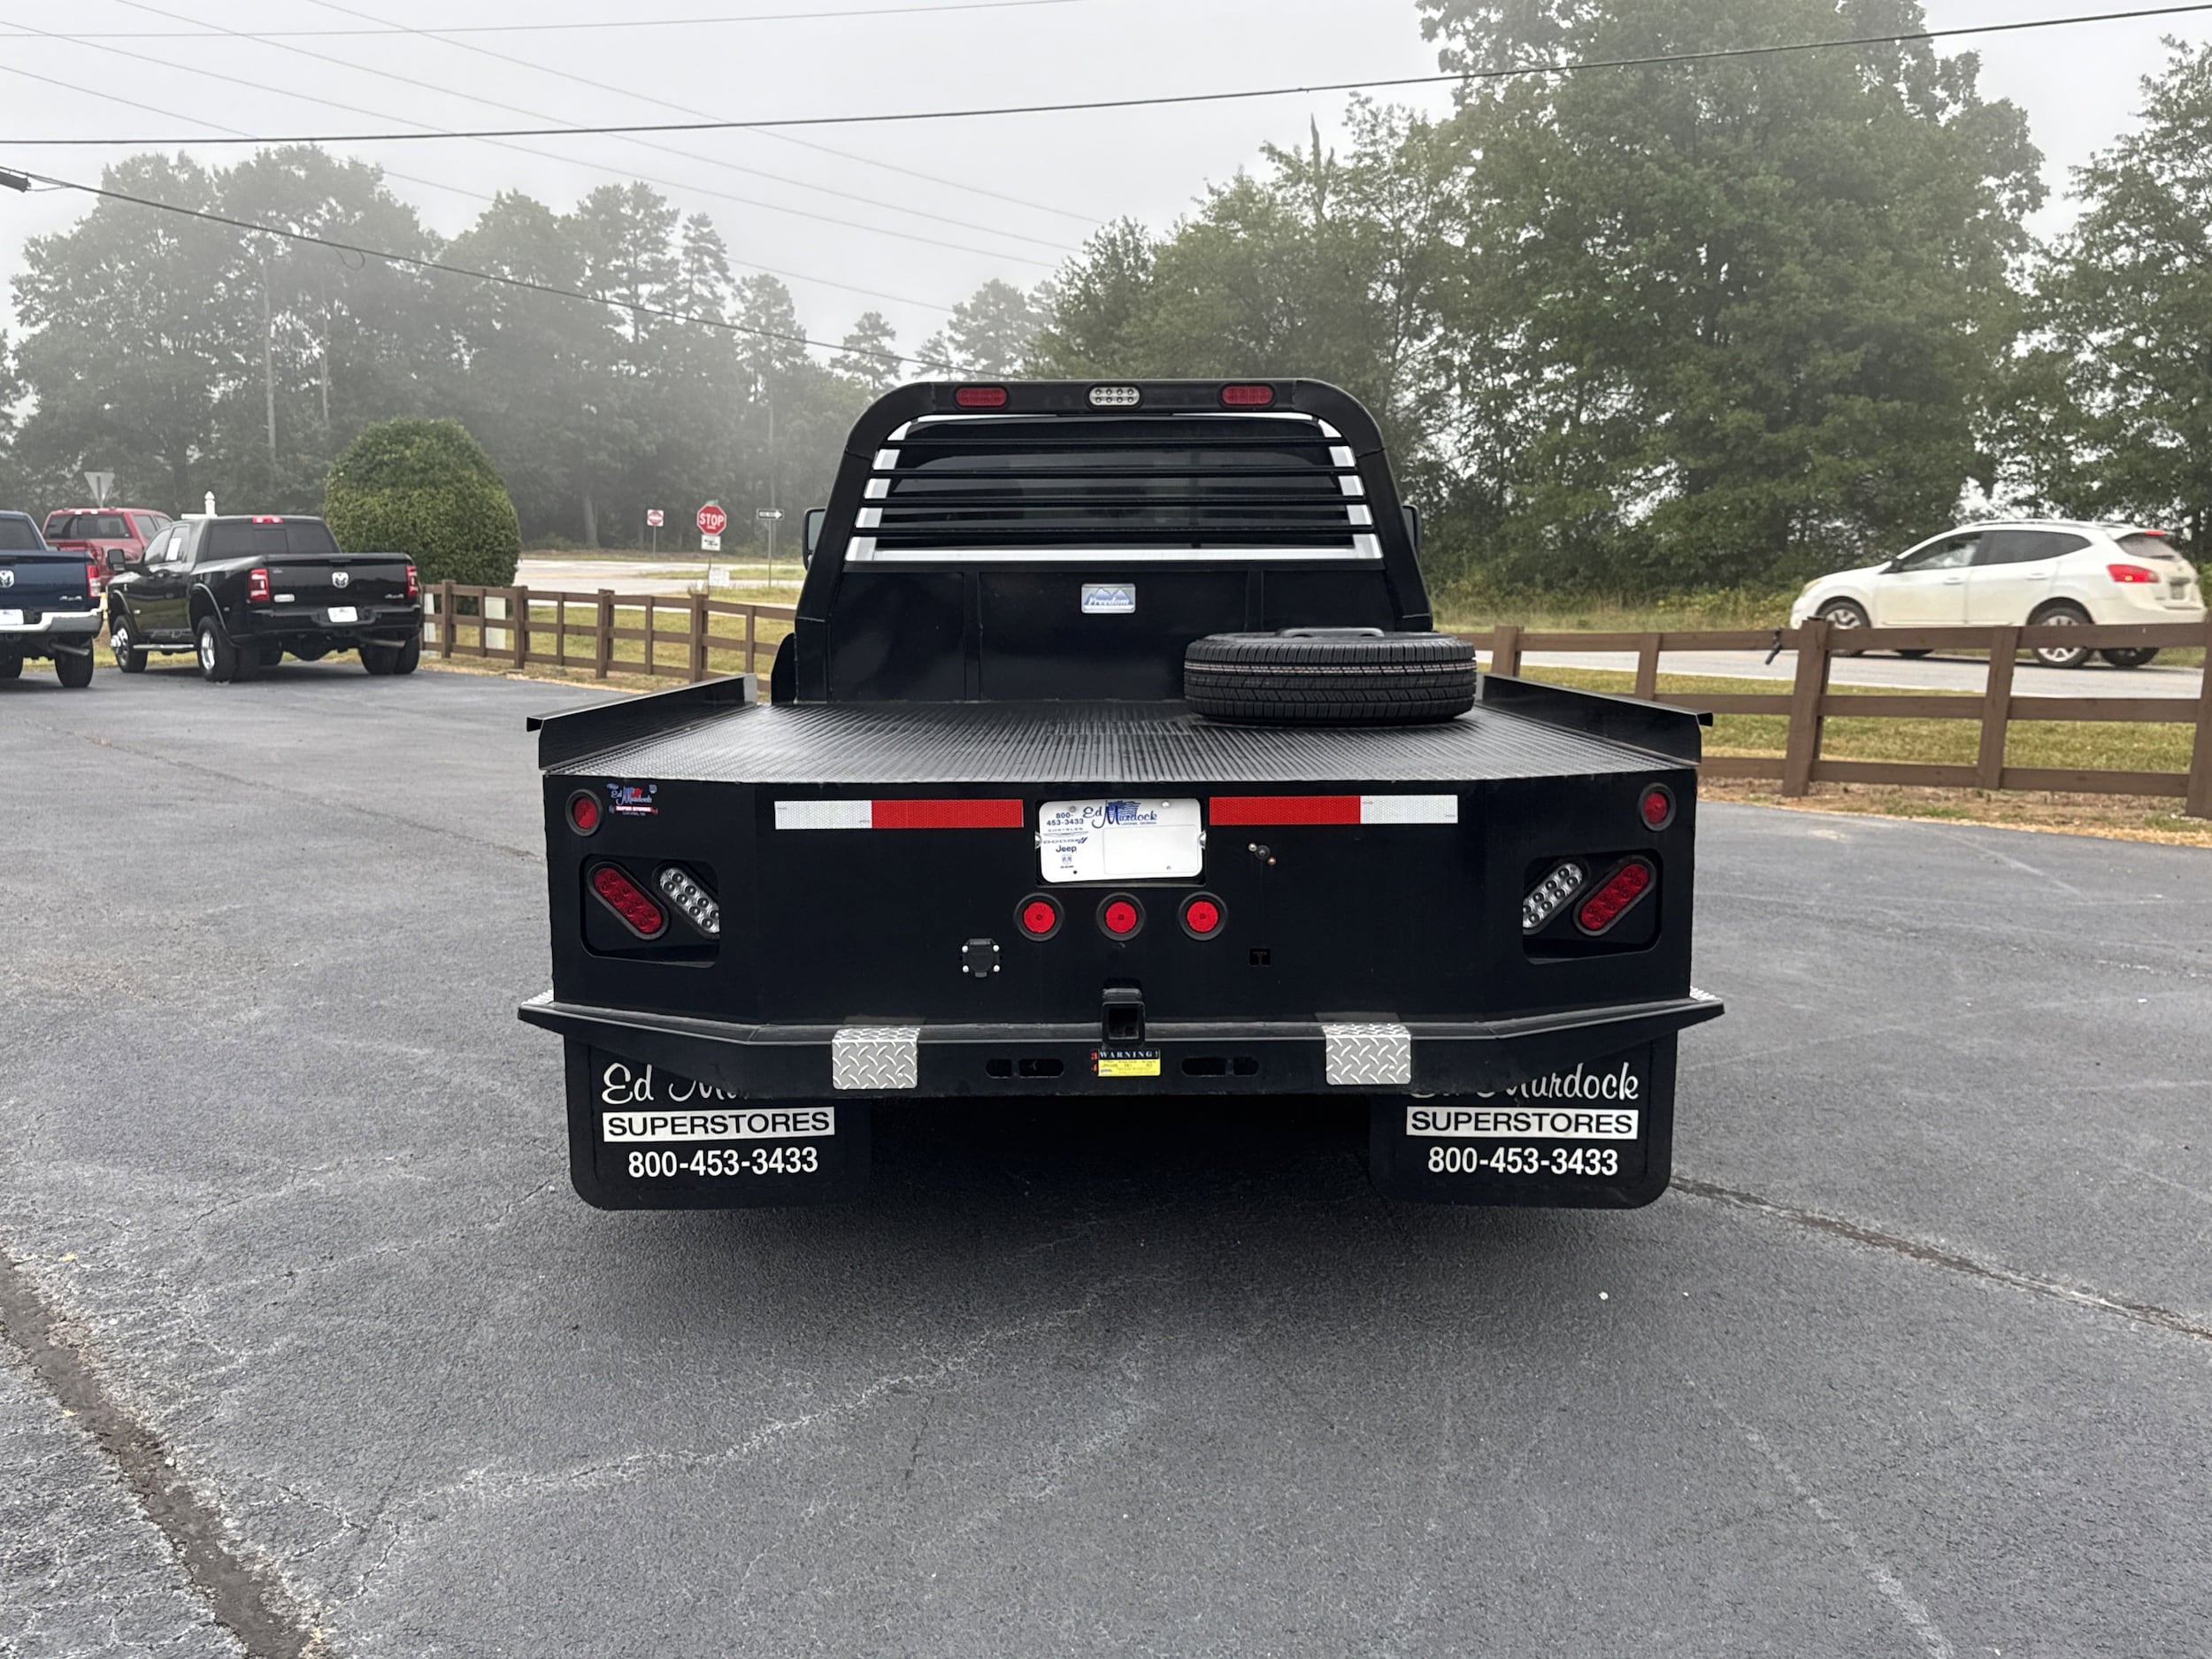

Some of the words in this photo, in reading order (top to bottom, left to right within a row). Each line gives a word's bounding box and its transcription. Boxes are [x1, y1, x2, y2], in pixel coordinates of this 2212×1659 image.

[699, 512, 725, 527] STOP
[1082, 806, 1102, 818] Ed
[1091, 800, 1158, 829] Murdock
[1056, 844, 1077, 854] Jeep
[602, 1062, 655, 1105] Ed
[608, 1111, 830, 1136] SUPERSTORES
[1410, 1110, 1633, 1134] SUPERSTORES
[627, 1146, 819, 1179] 800-453-3433
[1427, 1146, 1619, 1177] 800-453-3433
